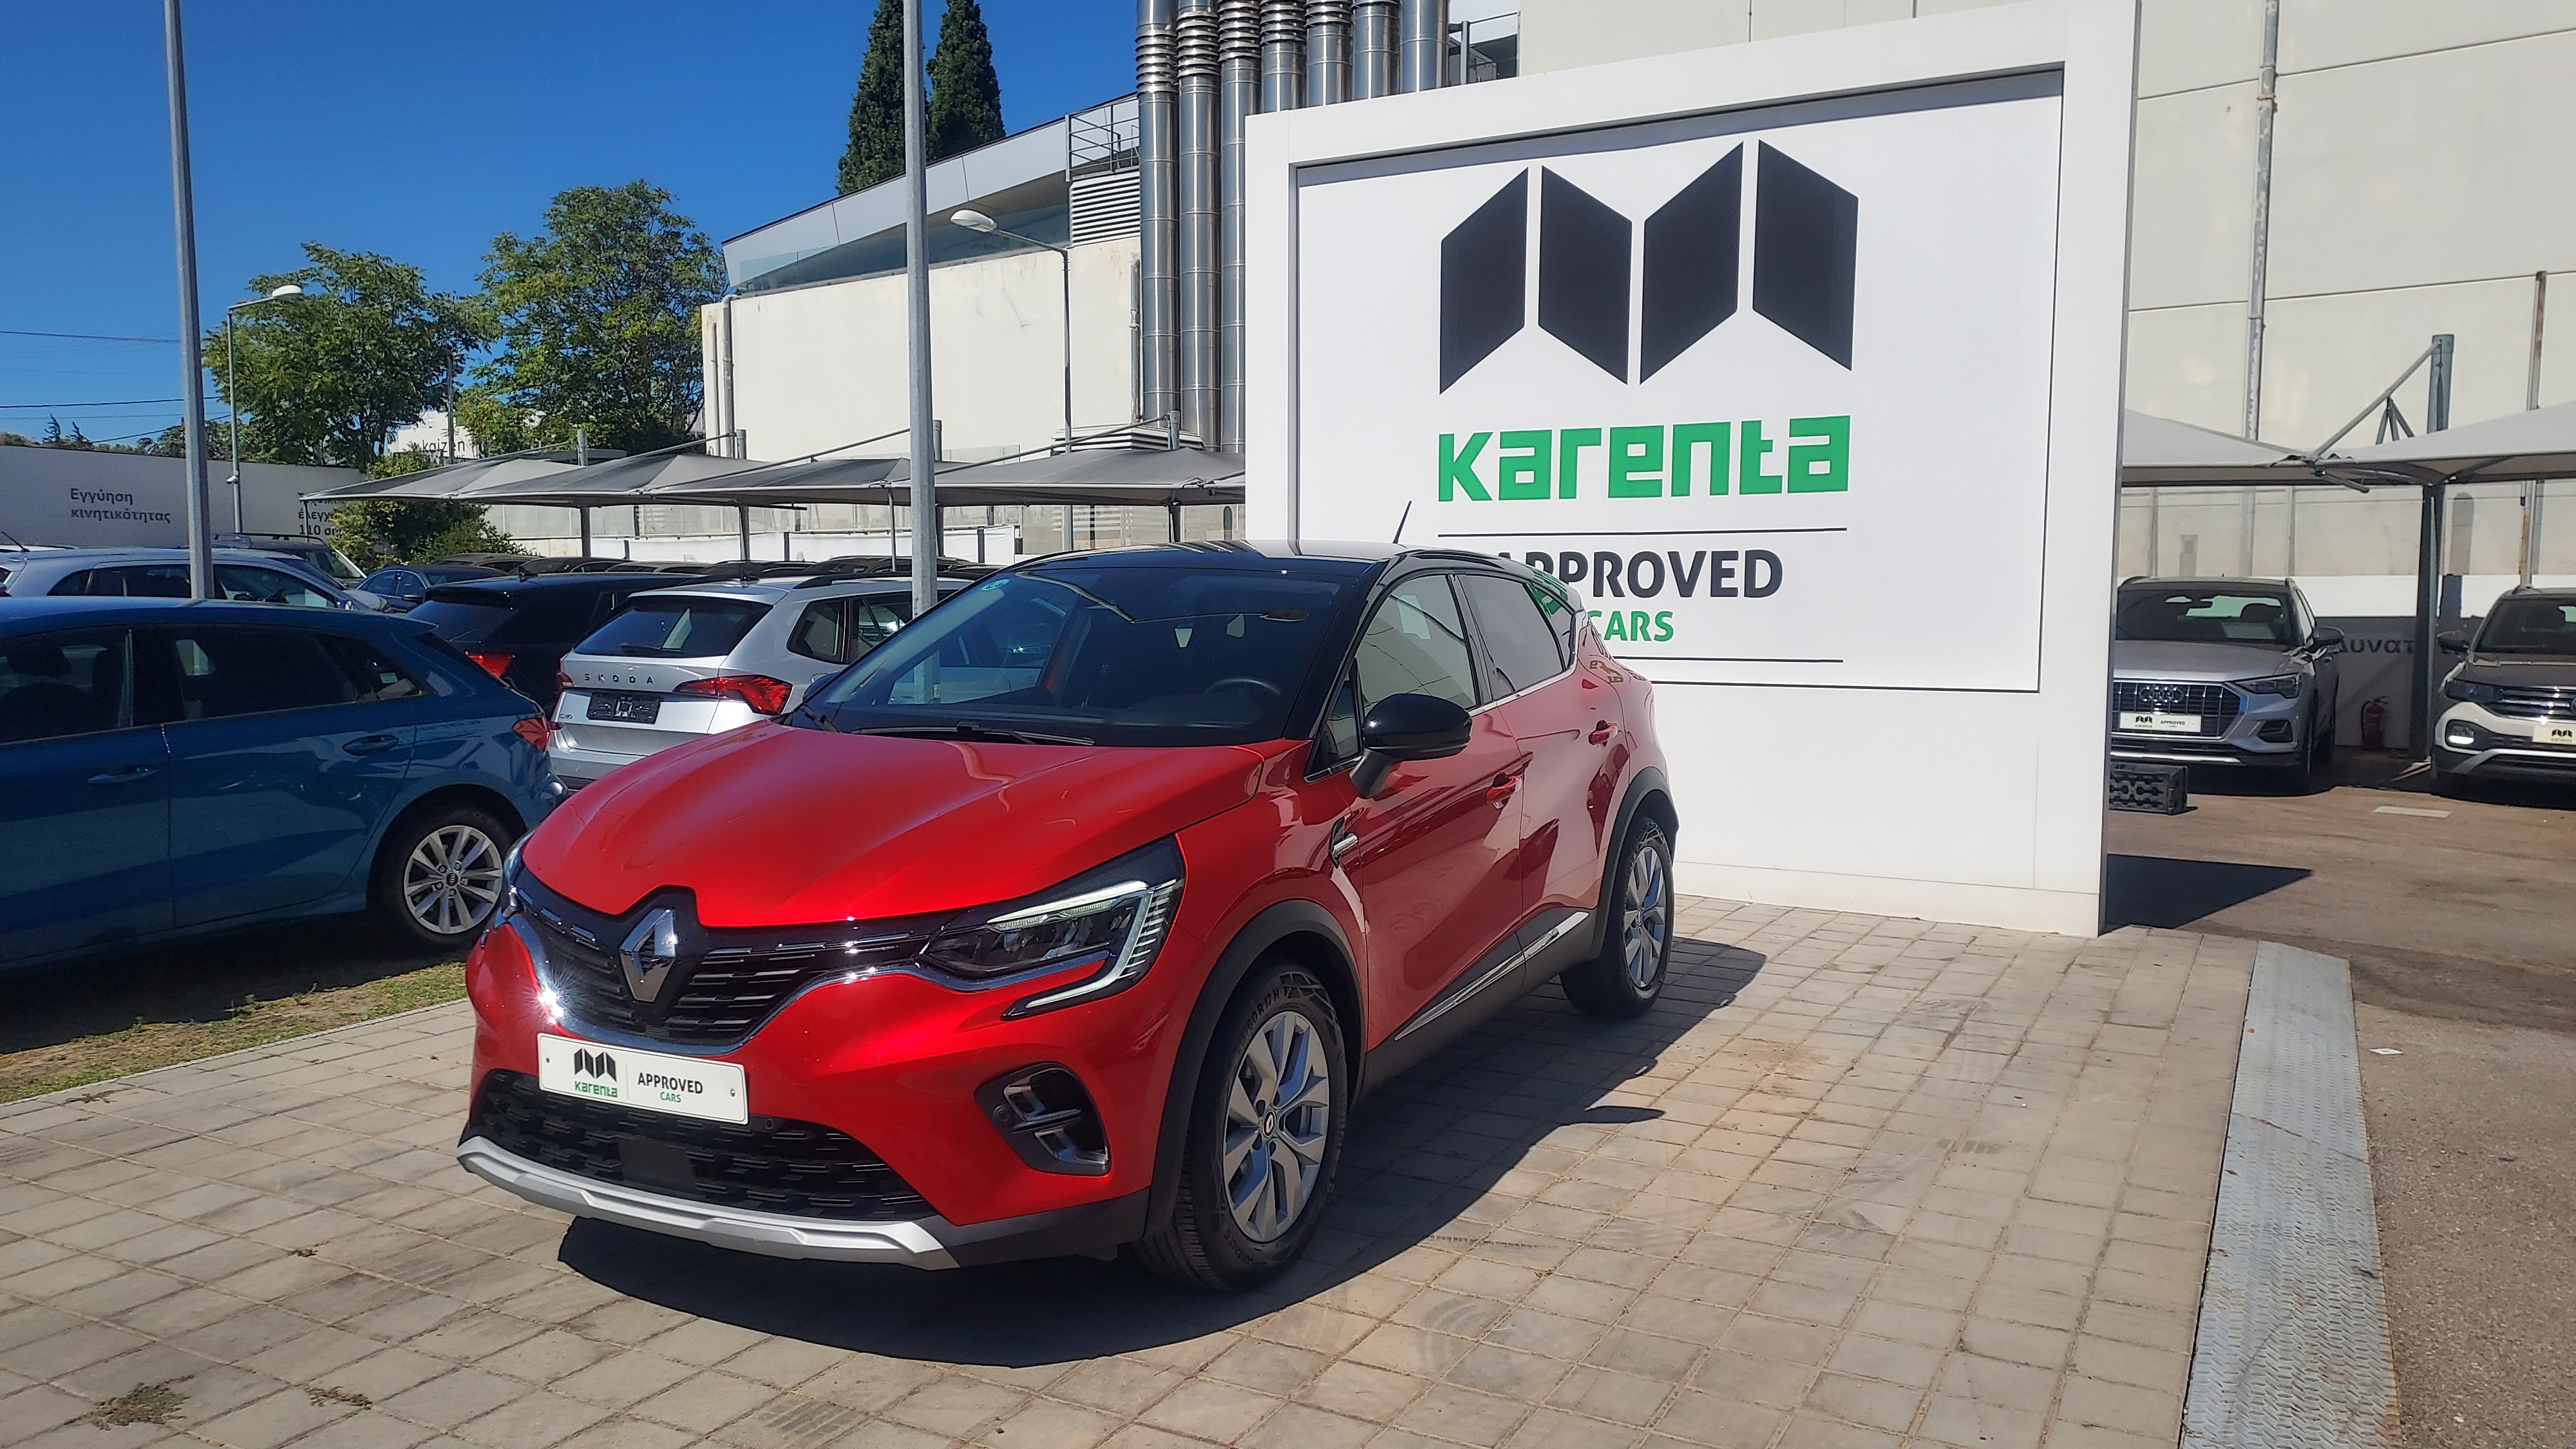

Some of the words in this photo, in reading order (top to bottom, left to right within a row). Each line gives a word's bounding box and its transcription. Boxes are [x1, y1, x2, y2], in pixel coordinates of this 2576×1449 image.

[422, 438, 466, 452] kaizn
[70, 487, 134, 506] Εγγύηση
[70, 507, 171, 524] κινητικότητας
[1498, 549, 1783, 599] PROVED
[638, 1072, 703, 1094] APPROVED
[660, 1092, 681, 1103] CARS
